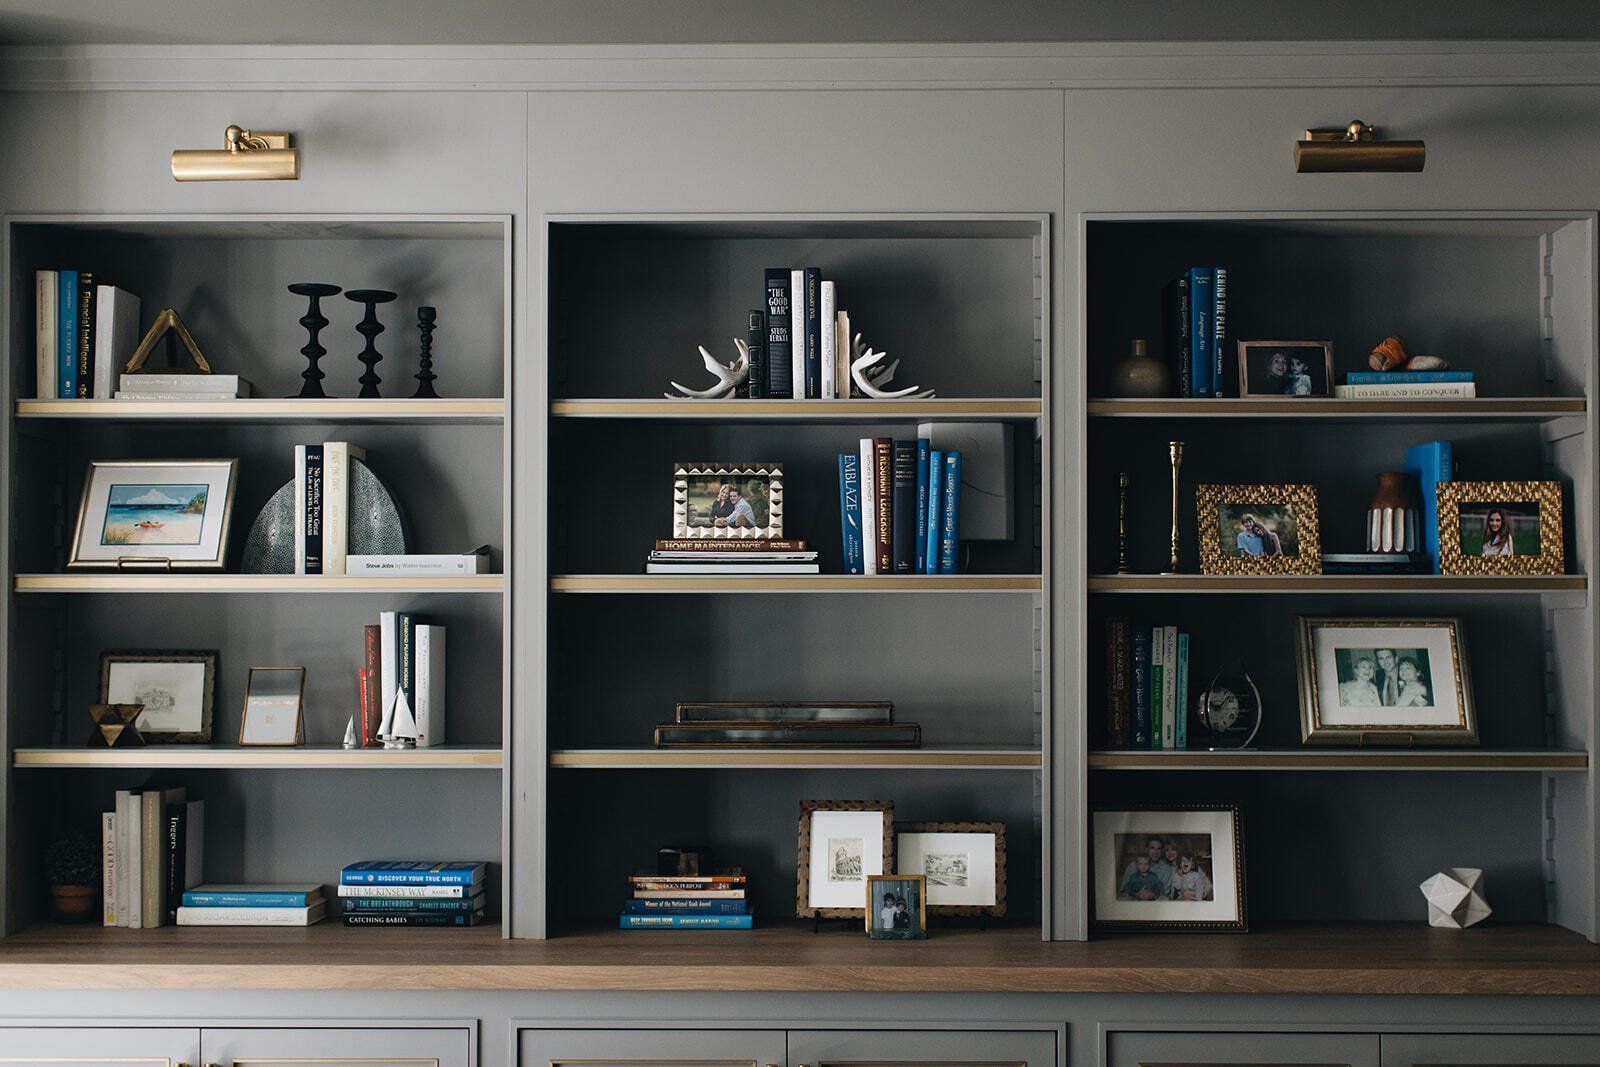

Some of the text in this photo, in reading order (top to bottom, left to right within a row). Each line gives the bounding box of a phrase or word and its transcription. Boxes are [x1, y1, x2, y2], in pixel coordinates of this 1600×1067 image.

[1216, 269, 1227, 298] BEHIND
[82, 291, 91, 328] Financial
[768, 298, 788, 306] GOOD
[1216, 300, 1226, 314] THE
[1198, 312, 1206, 337] Language
[1216, 316, 1226, 340] PLATE
[80, 328, 90, 376] Intelligence
[1358, 390, 1368, 398] TO
[1422, 388, 1460, 396] CONQUER
[314, 467, 320, 476] No
[844, 454, 858, 511] EMBLAZE
[880, 456, 890, 546] RESONANT LEADERSHIP
[170, 816, 180, 850] Triggers
[344, 887, 426, 896] THE McKINSEY WAY
[360, 900, 370, 908] THE
[370, 900, 414, 908] BREAKTHROUGH
